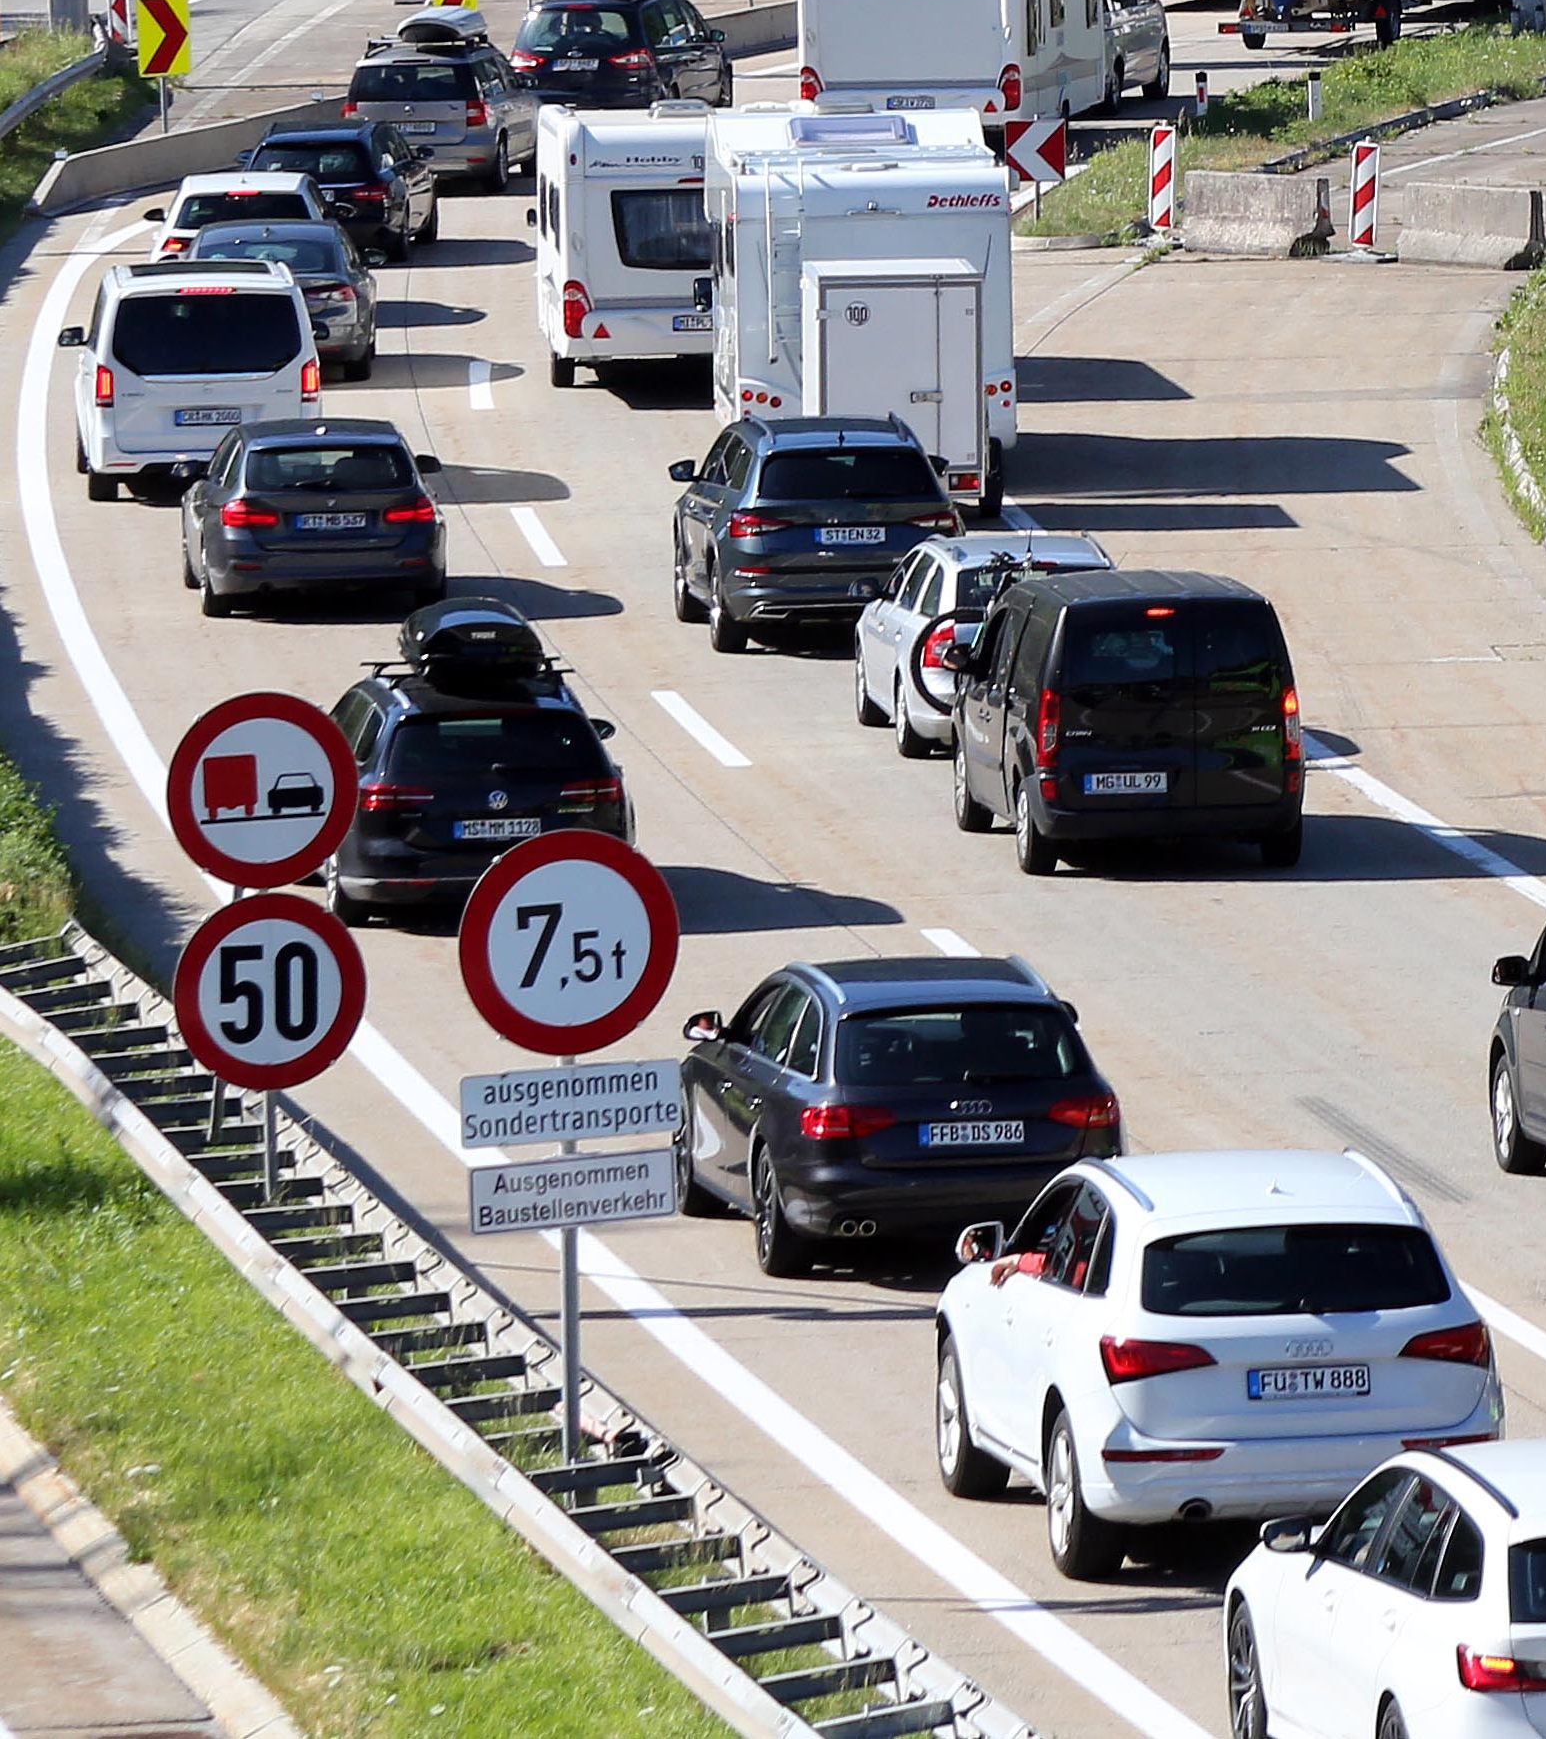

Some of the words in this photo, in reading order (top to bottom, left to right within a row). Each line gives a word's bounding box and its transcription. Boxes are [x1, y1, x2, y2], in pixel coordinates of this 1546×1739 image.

[926, 193, 1002, 209] Dethleffs
[847, 305, 868, 323] 100
[826, 529, 840, 541] ST
[1096, 776, 1115, 789] MG
[1123, 775, 1141, 789] UL
[1144, 775, 1162, 788] 99
[463, 822, 479, 836] MS
[508, 819, 541, 834] 1128
[219, 940, 319, 1045] 50
[483, 1068, 659, 1107] ausgenommen
[464, 1098, 680, 1141] Sondertransporte
[930, 1124, 960, 1142] FFB
[971, 1124, 991, 1141] DS
[994, 1123, 1022, 1140] 986
[492, 1161, 650, 1197] Ausgenommen
[478, 1187, 669, 1228] Baustellenverkehr
[1300, 1370, 1325, 1390] TW
[1330, 1369, 1366, 1389] 888
